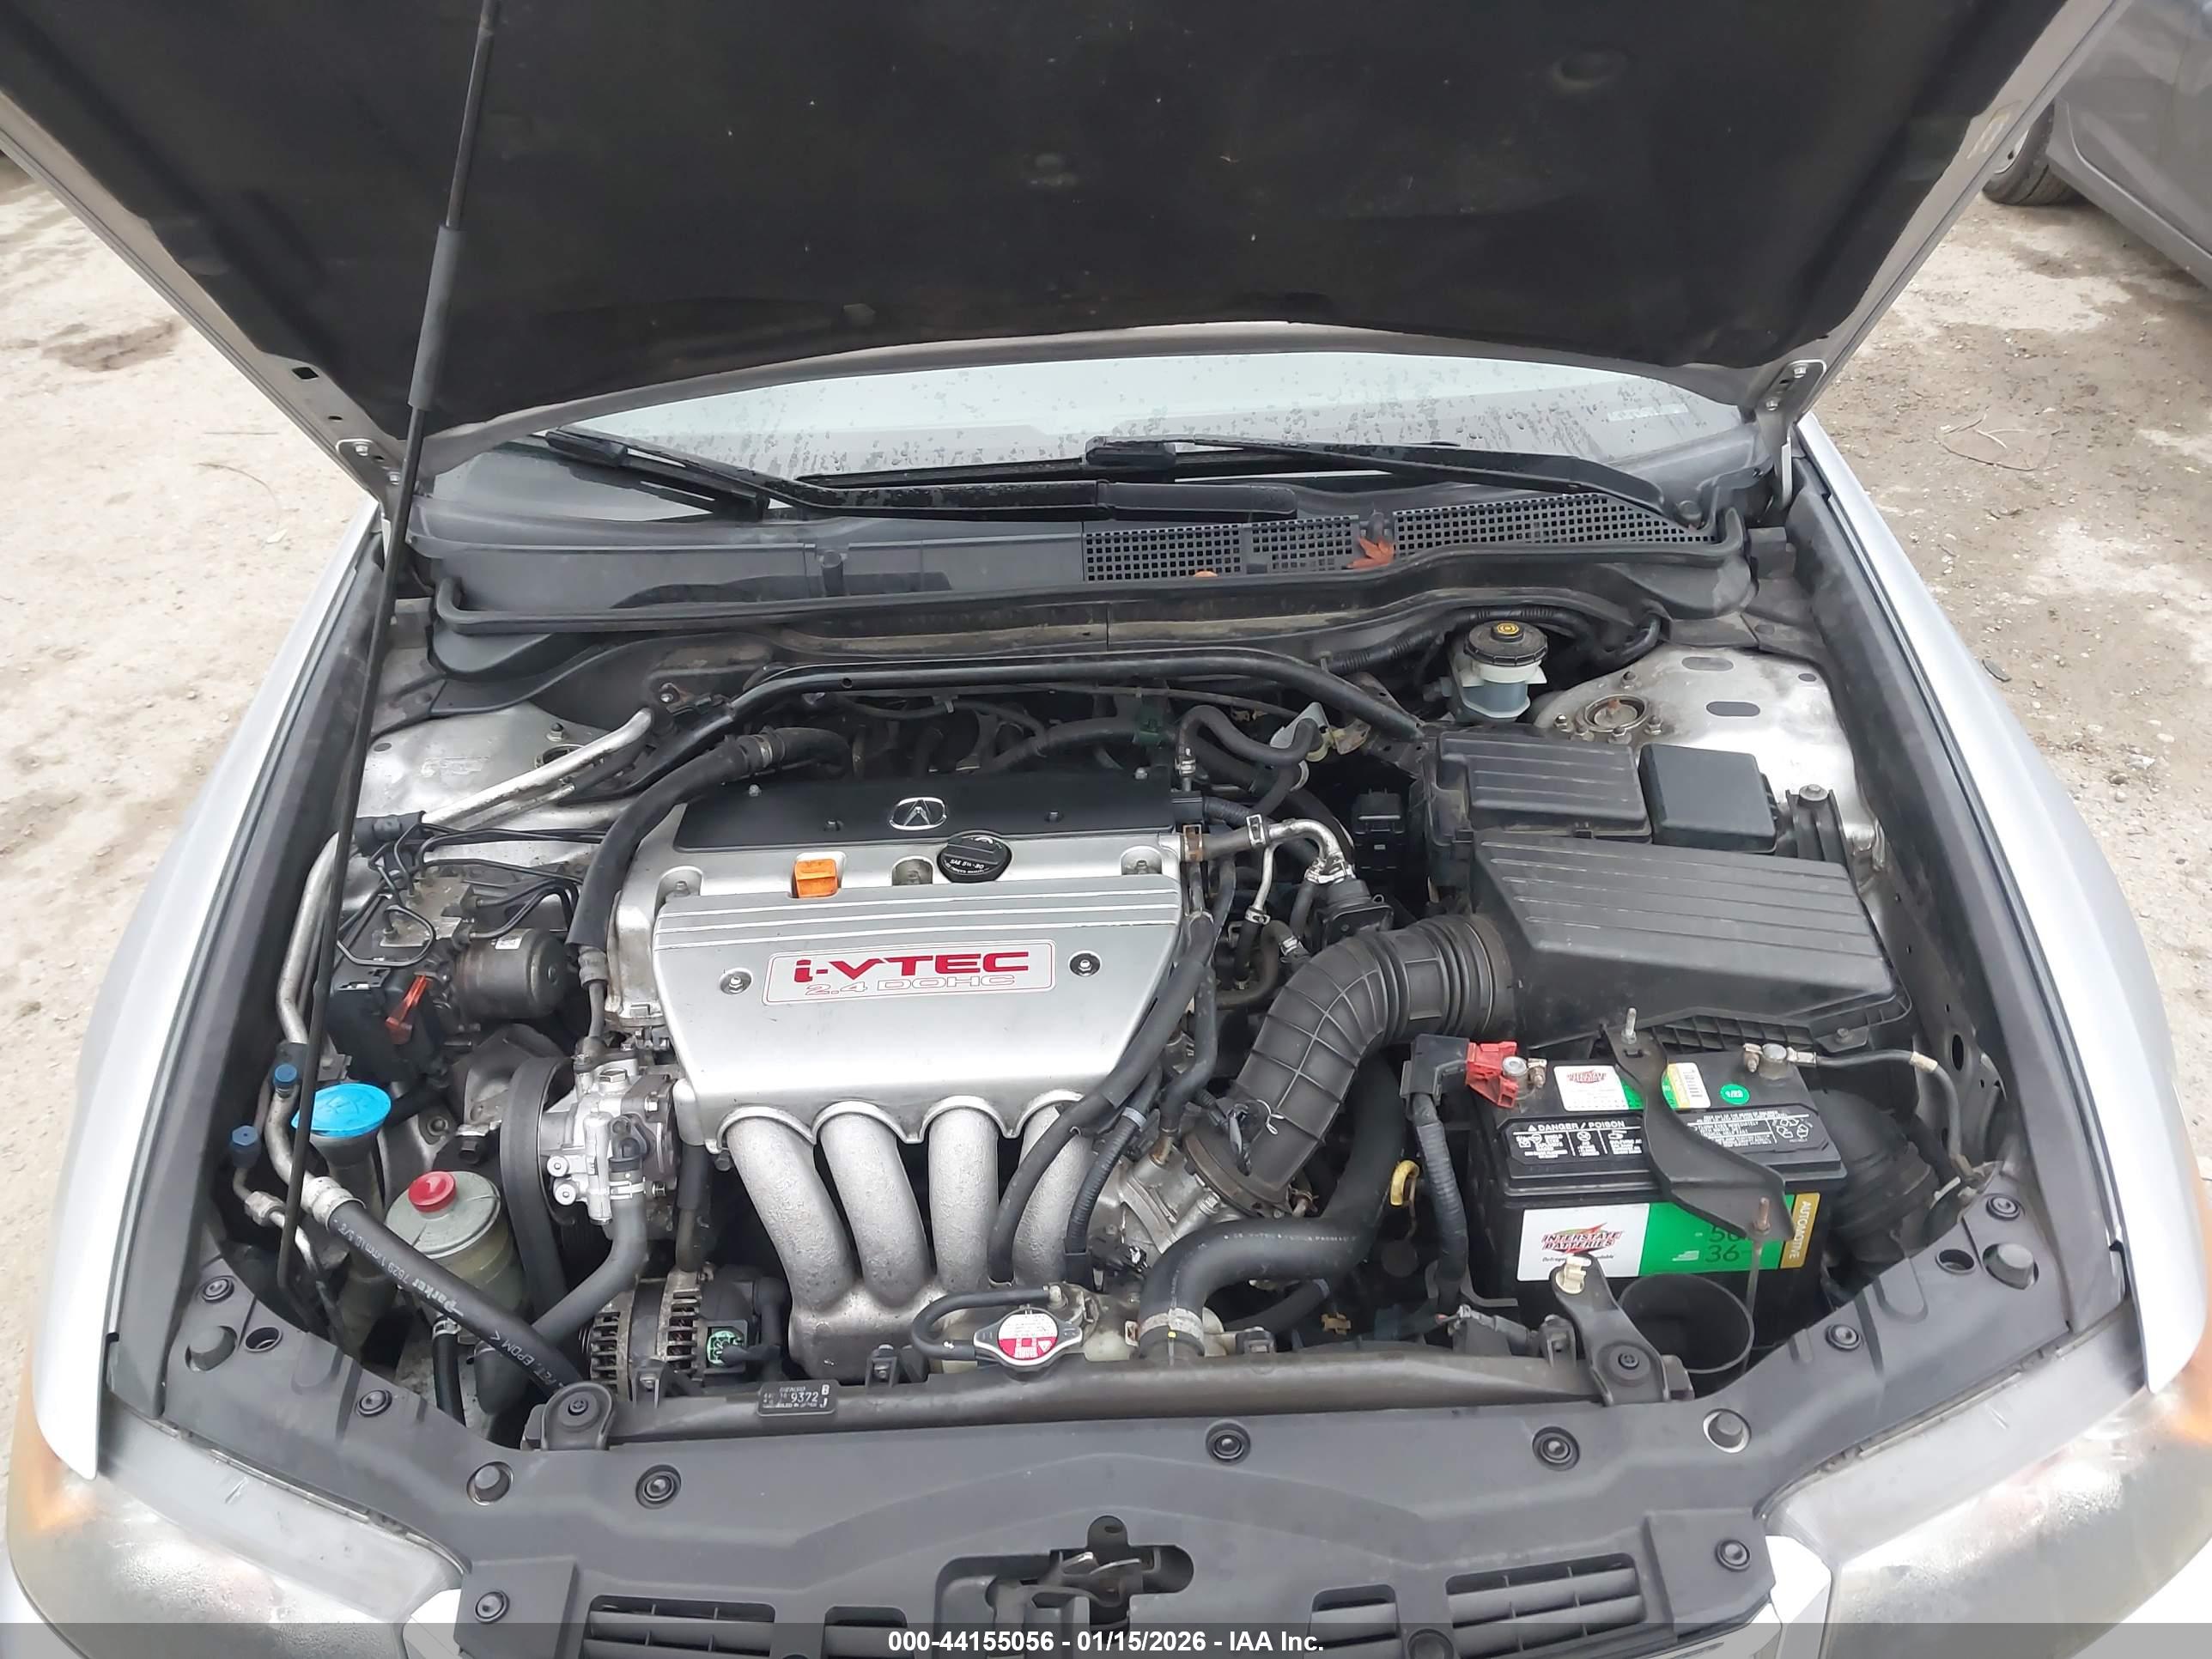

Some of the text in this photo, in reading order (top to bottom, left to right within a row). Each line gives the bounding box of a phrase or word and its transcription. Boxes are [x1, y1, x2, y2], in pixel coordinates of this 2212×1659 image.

[794, 951, 1029, 982] i-VTEC
[805, 975, 1015, 995] 2.4 DOHC
[1537, 1121, 1579, 1131] DANGER
[1542, 1231, 1623, 1243] INTERSTATE
[1790, 1200, 1811, 1260] AUTOMOTIVE
[1542, 1240, 1613, 1250] BATTERIES
[411, 1277, 465, 1317] Parker
[501, 1340, 535, 1366] EPDM
[821, 1384, 830, 1395] B
